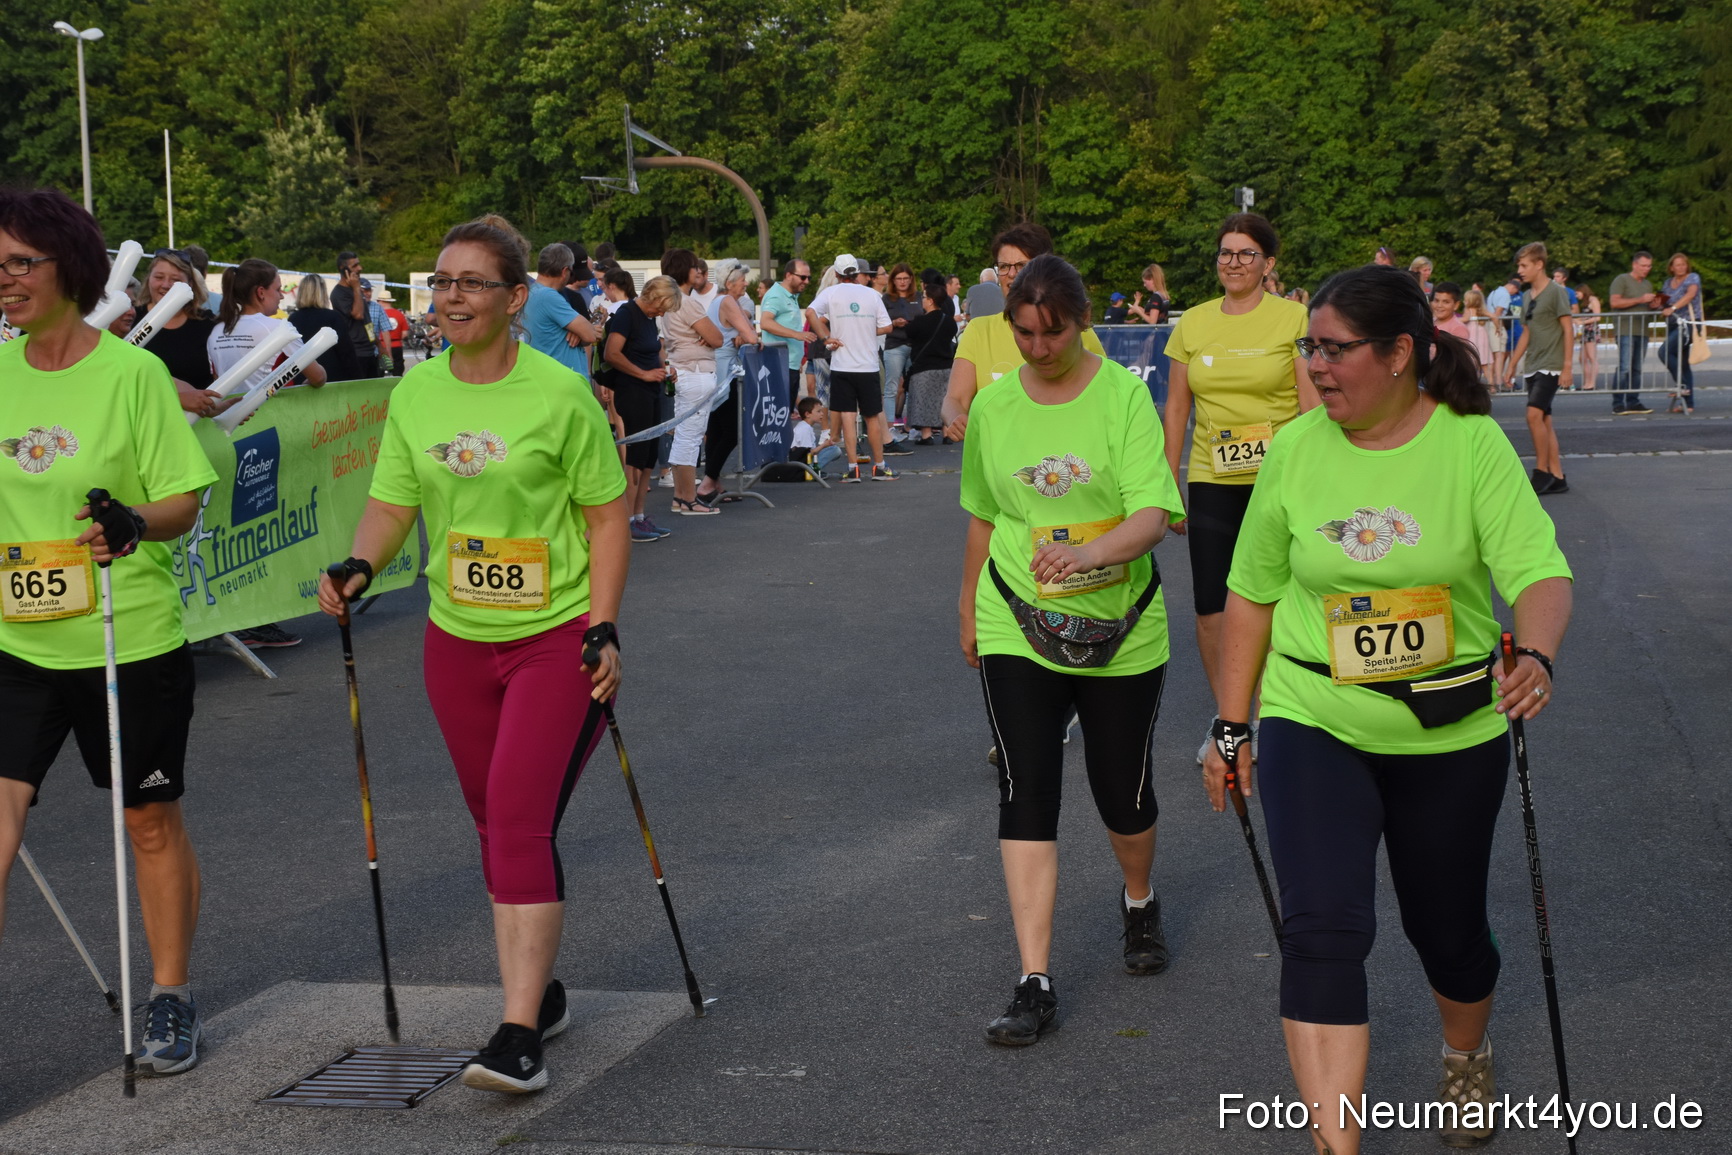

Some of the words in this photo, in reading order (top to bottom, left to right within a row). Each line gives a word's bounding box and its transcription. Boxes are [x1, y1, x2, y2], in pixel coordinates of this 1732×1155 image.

[312, 402, 359, 449] Gesunde
[361, 399, 388, 429] Firme
[332, 441, 368, 480] laufen
[1217, 440, 1266, 462] 1234
[243, 459, 274, 480] Fischer
[244, 472, 270, 487] AUTOMOBILE
[211, 485, 319, 575] firmenlauf
[10, 568, 67, 600] 665
[219, 562, 268, 596] neumarkt
[467, 561, 524, 590] 668
[1062, 577, 1108, 591] Dorfner-Apotheken
[1087, 570, 1112, 581] Andrea
[453, 584, 512, 598] Kerschensteiner
[18, 600, 35, 608] Gast
[1343, 607, 1391, 620] firmenlauf
[1397, 609, 1420, 620] walk
[1421, 607, 1443, 618] 2019
[1354, 620, 1425, 658] 670
[1363, 661, 1424, 674] Dorfner-Apotheken
[1364, 657, 1397, 668] Speitel
[1400, 653, 1421, 663] Anja
[1223, 726, 1235, 755] LEKI
[139, 778, 170, 789] adidas
